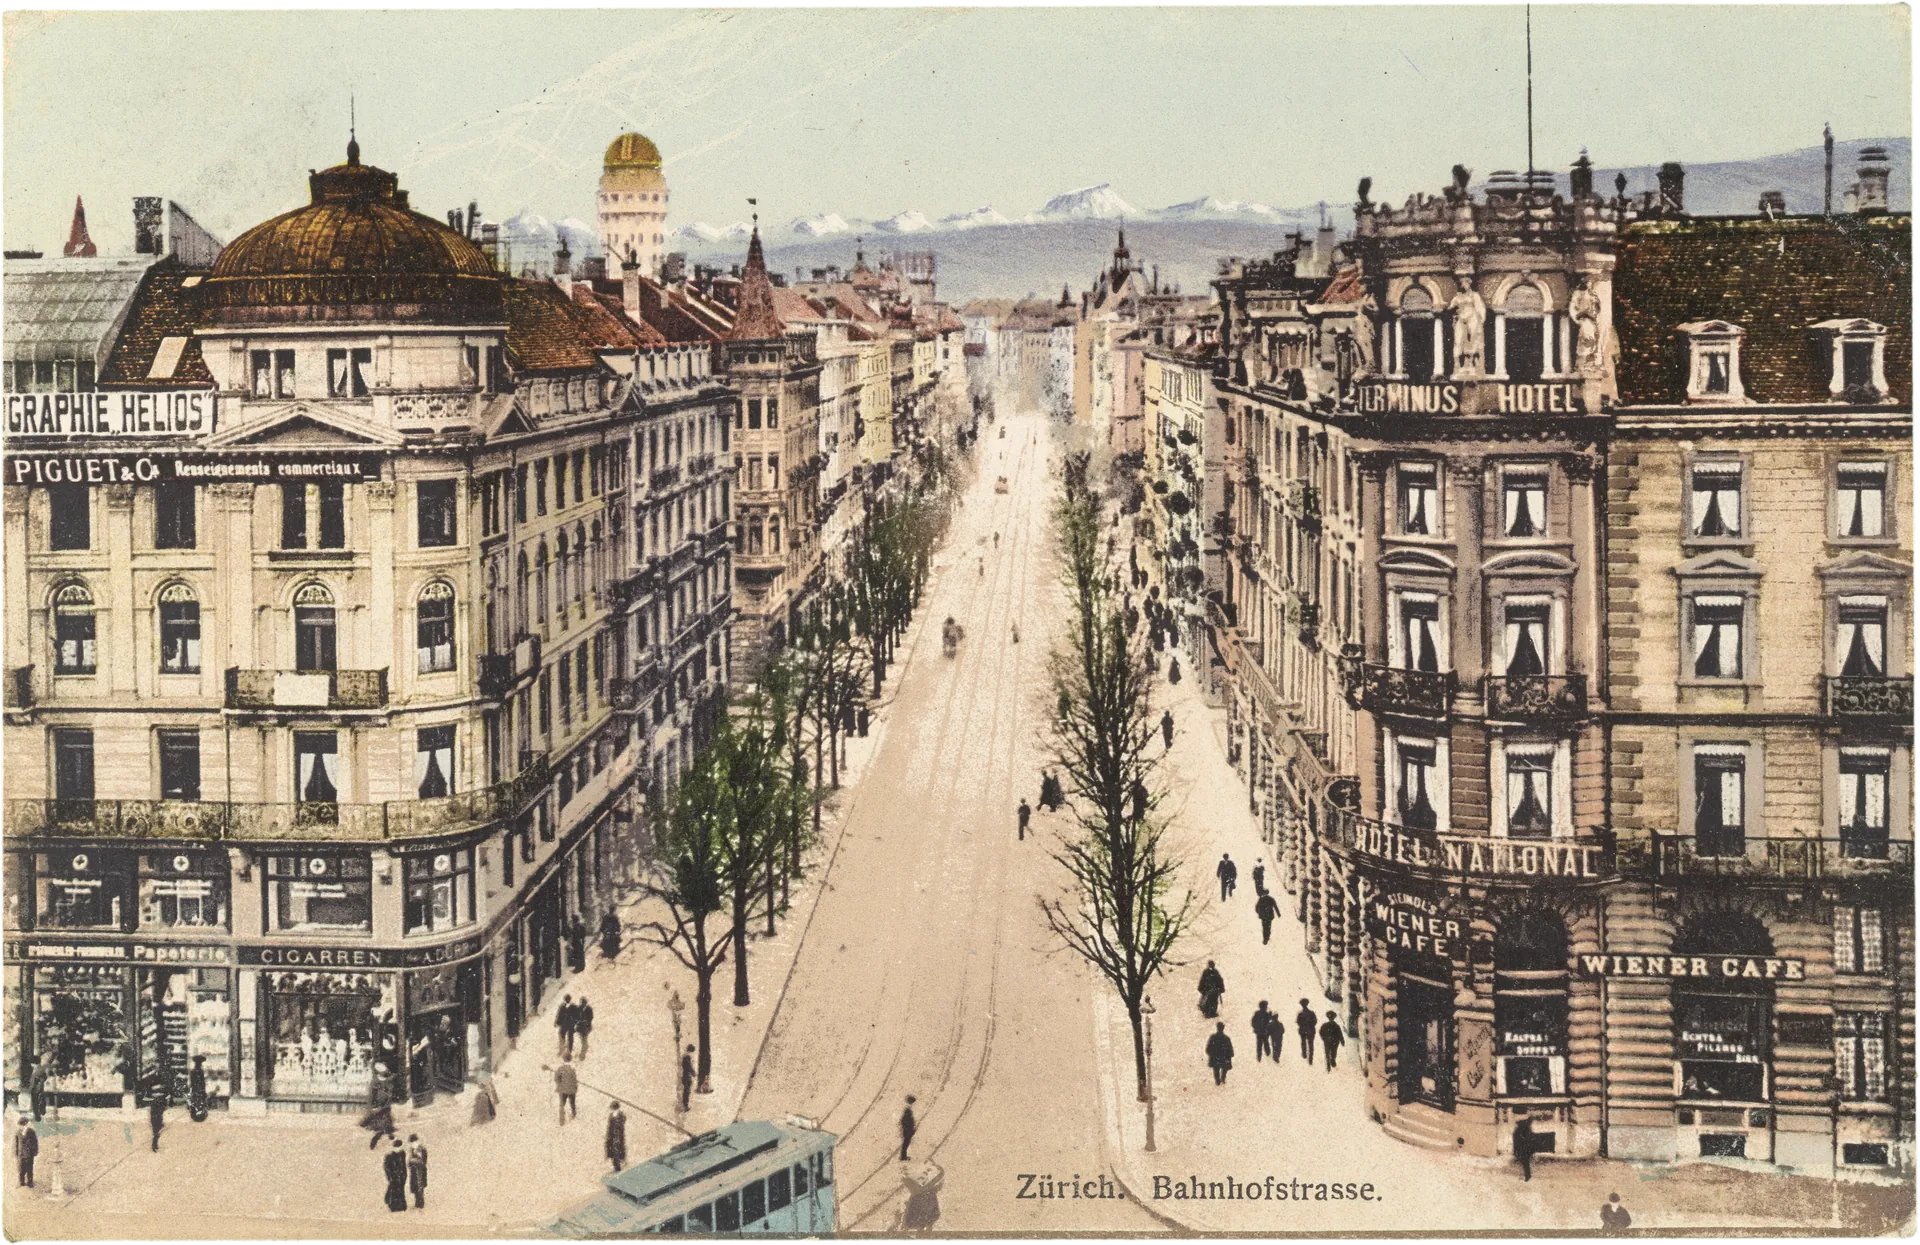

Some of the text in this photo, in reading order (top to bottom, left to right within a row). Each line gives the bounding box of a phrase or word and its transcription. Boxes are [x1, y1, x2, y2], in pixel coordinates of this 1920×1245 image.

[1358, 384, 1578, 413] TERMINUS HOTEL
[3, 394, 110, 433] GRAPHIE
[277, 460, 362, 476] commerciaux
[1443, 838, 1600, 877] NATIONAL
[1376, 902, 1460, 938] WIENER
[134, 945, 226, 961] Papeterie
[1386, 925, 1449, 957] CAFE
[261, 949, 382, 965] CIGARREN
[1581, 954, 1804, 980] WIENER CAFE
